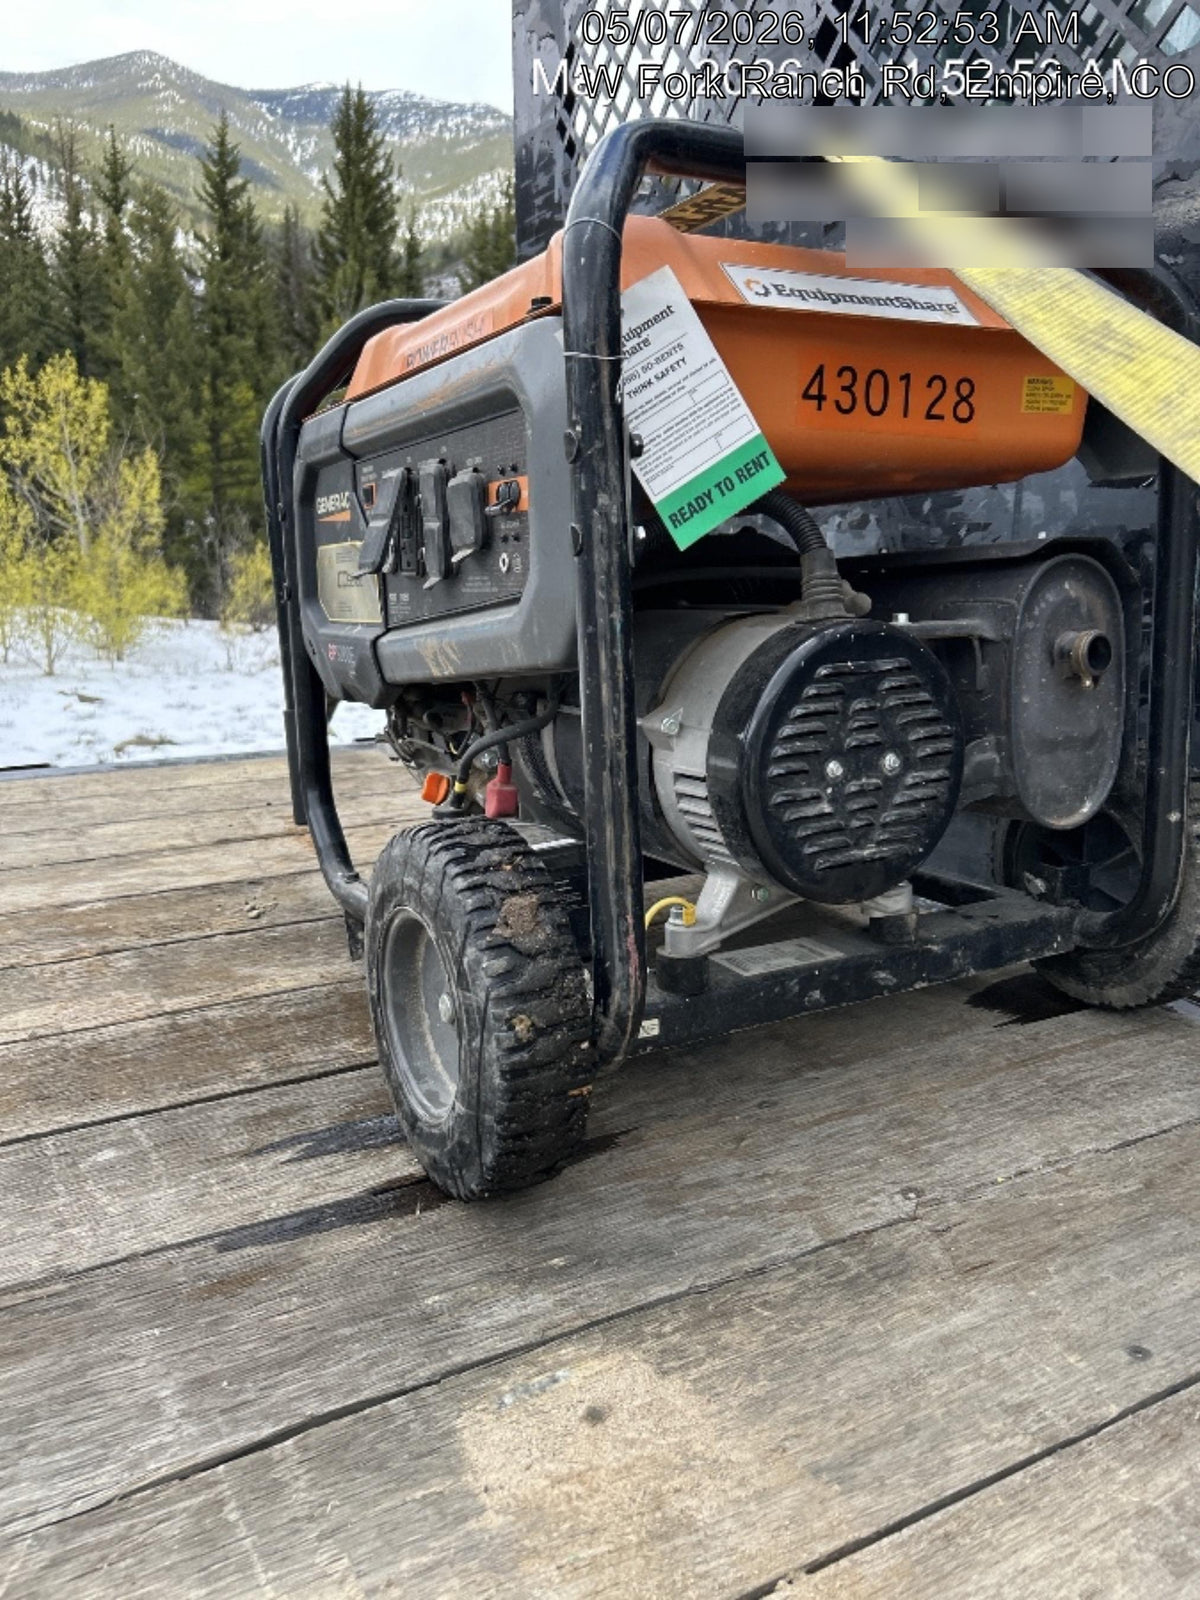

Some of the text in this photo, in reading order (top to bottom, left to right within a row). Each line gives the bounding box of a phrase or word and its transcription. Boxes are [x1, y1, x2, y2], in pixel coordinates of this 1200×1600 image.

[769, 283, 960, 314] EquipmentShare
[626, 378, 655, 400] THINK
[653, 356, 688, 381] SAFETY
[801, 364, 976, 424] 430128
[668, 450, 771, 529] READY TO RENT
